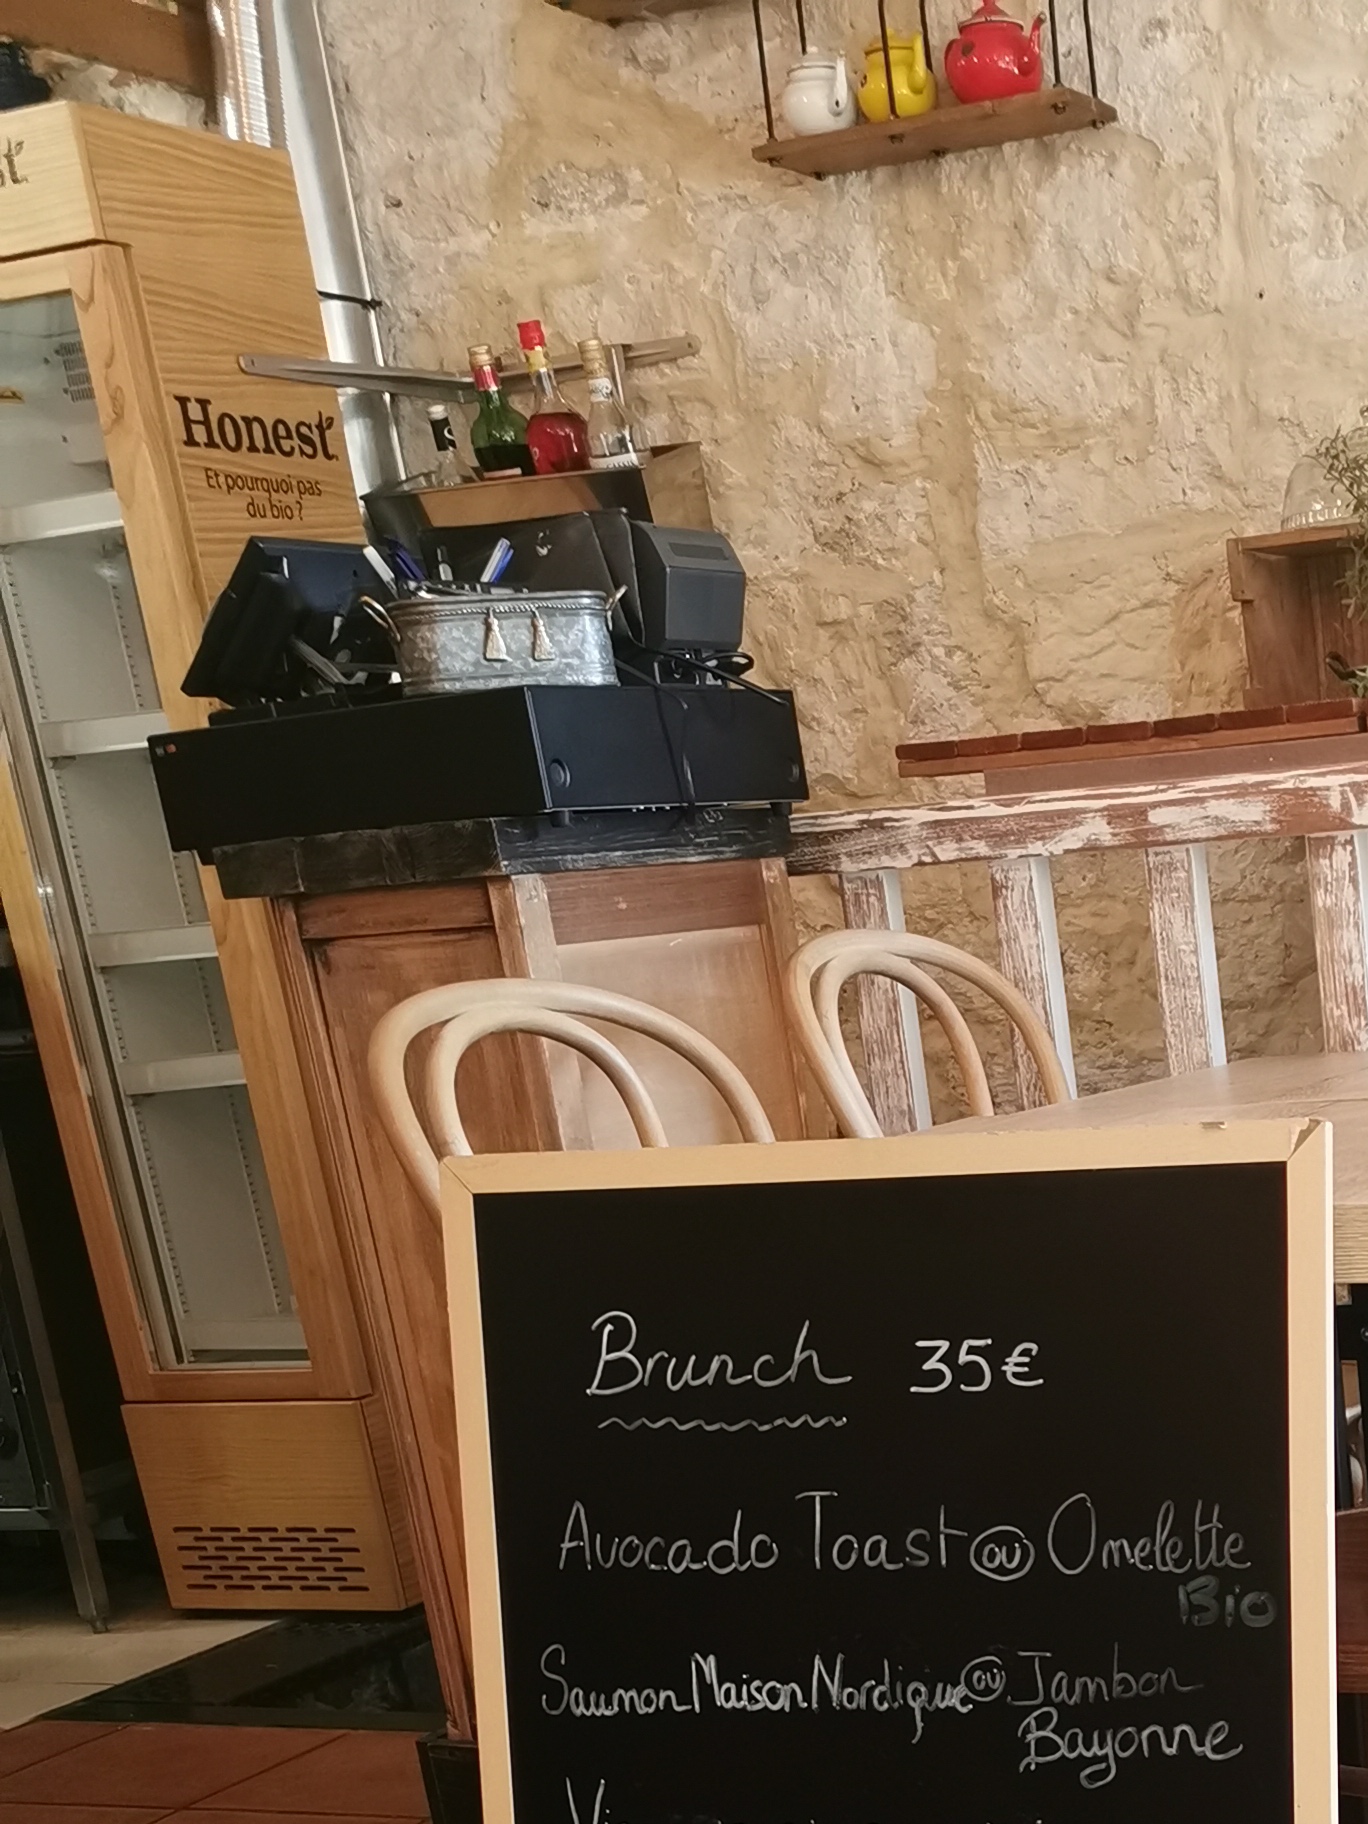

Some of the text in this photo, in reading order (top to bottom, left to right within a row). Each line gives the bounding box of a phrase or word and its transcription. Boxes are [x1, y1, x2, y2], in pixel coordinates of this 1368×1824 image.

[173, 394, 338, 461] Honest
[204, 468, 322, 500] Et pourquoi pas
[246, 497, 266, 518] du
[269, 498, 294, 520] bio
[586, 1311, 1044, 1395] Brunch 35€
[560, 1501, 778, 1574] Avocado
[796, 1491, 967, 1570] Toast
[1048, 1493, 1251, 1574] Omelette
[1179, 1576, 1274, 1627] Bio
[541, 1645, 690, 1716] Saumon
[688, 1653, 807, 1713] Maison
[812, 1654, 972, 1743] Nordique
[1007, 1644, 1203, 1706] Jambon
[1018, 1708, 1243, 1788] Bayonne
